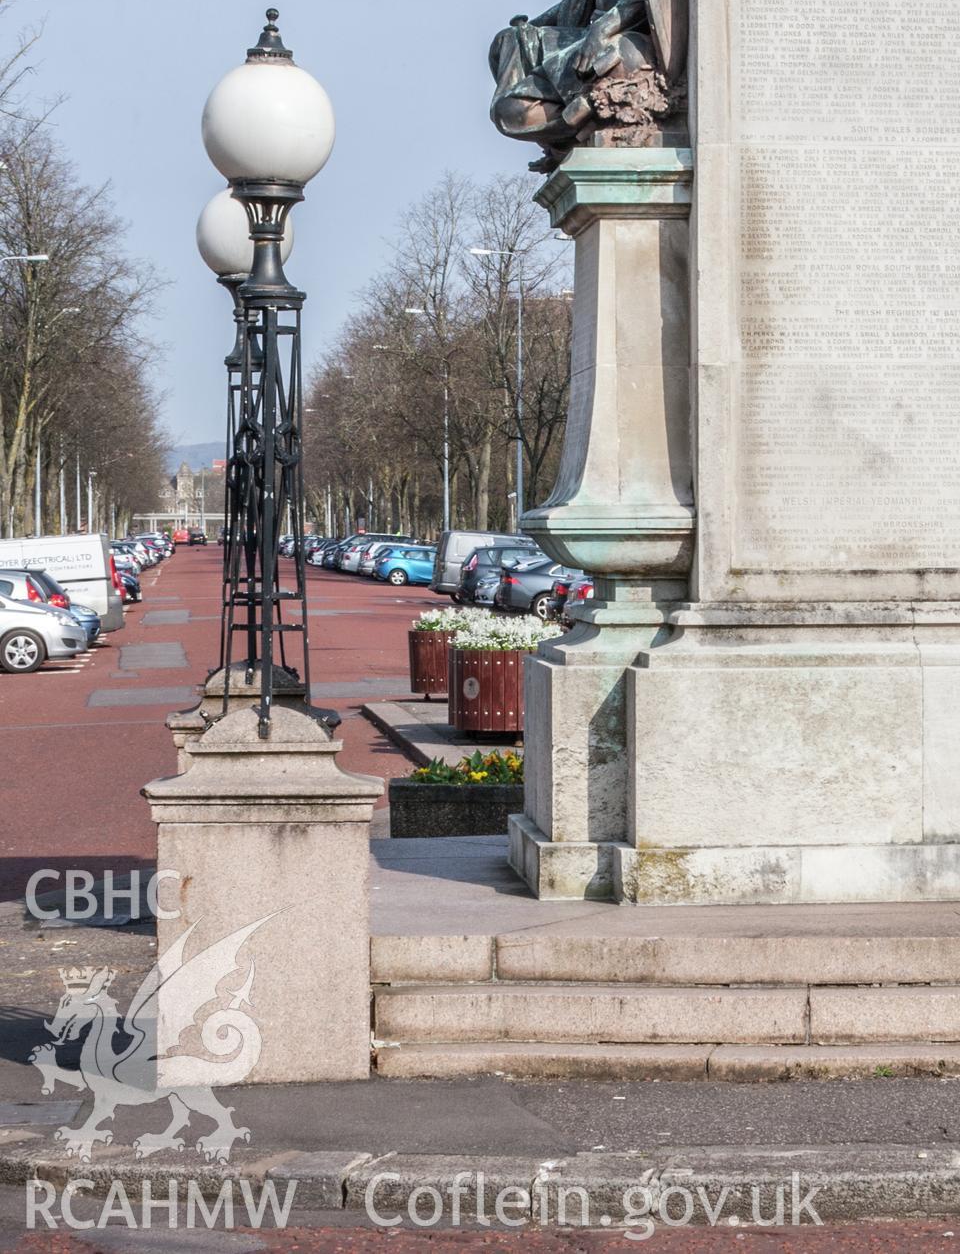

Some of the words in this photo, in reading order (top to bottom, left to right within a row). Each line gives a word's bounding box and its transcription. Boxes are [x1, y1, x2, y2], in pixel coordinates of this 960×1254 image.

[851, 125, 879, 134] SOUTH
[884, 126, 911, 134] WALES
[810, 264, 851, 272] BATTALION
[855, 264, 880, 272] ROYAL
[884, 264, 911, 272] SOUTH
[782, 497, 817, 506] WELSH
[822, 497, 867, 506] IMPERIAL
[871, 497, 923, 506] YEOMANRY
[76, 553, 92, 562] LTD
